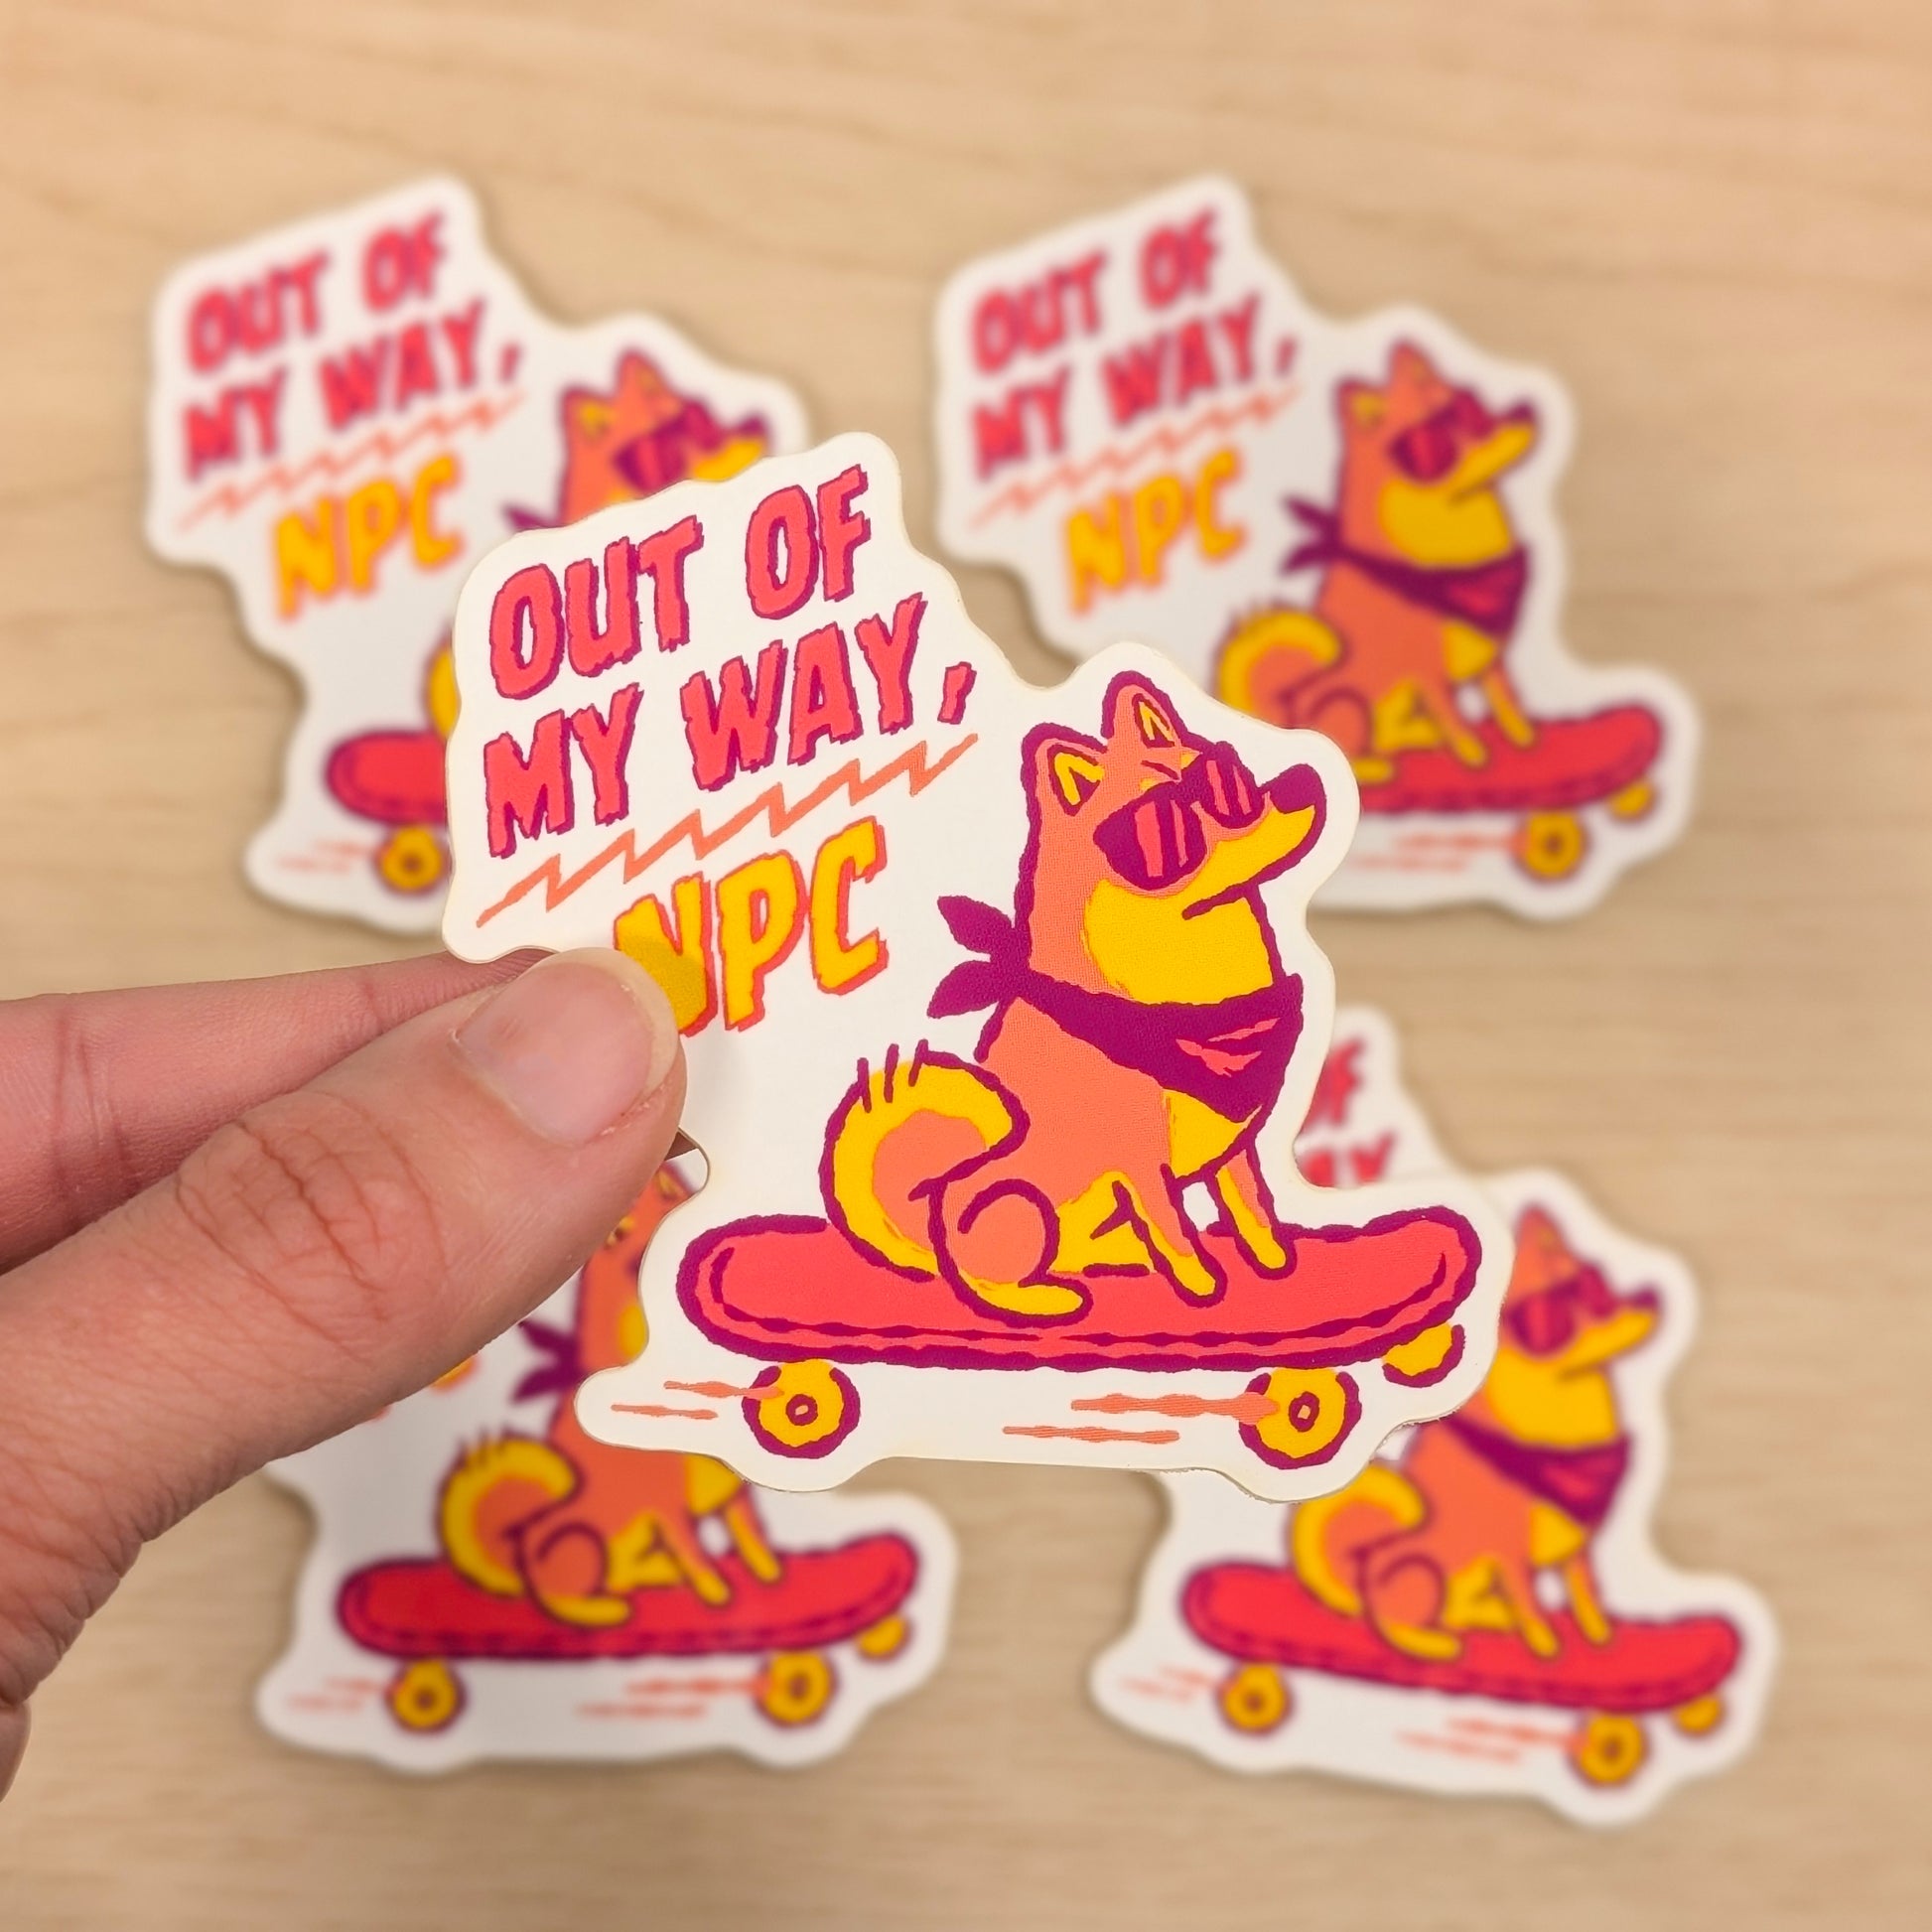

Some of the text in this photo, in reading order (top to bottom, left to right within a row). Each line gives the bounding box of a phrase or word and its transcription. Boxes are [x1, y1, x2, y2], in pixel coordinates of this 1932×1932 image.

[186, 207, 447, 373] OUT OF
[971, 207, 1219, 374] OUT OF
[182, 297, 520, 481] MY WAY,
[970, 291, 1297, 481] MY WAY,
[272, 453, 466, 620] NPC
[489, 464, 871, 700] OUT OF
[1065, 447, 1247, 616] NPC
[483, 592, 977, 859] MY WAY,
[614, 815, 889, 1036] NPC
